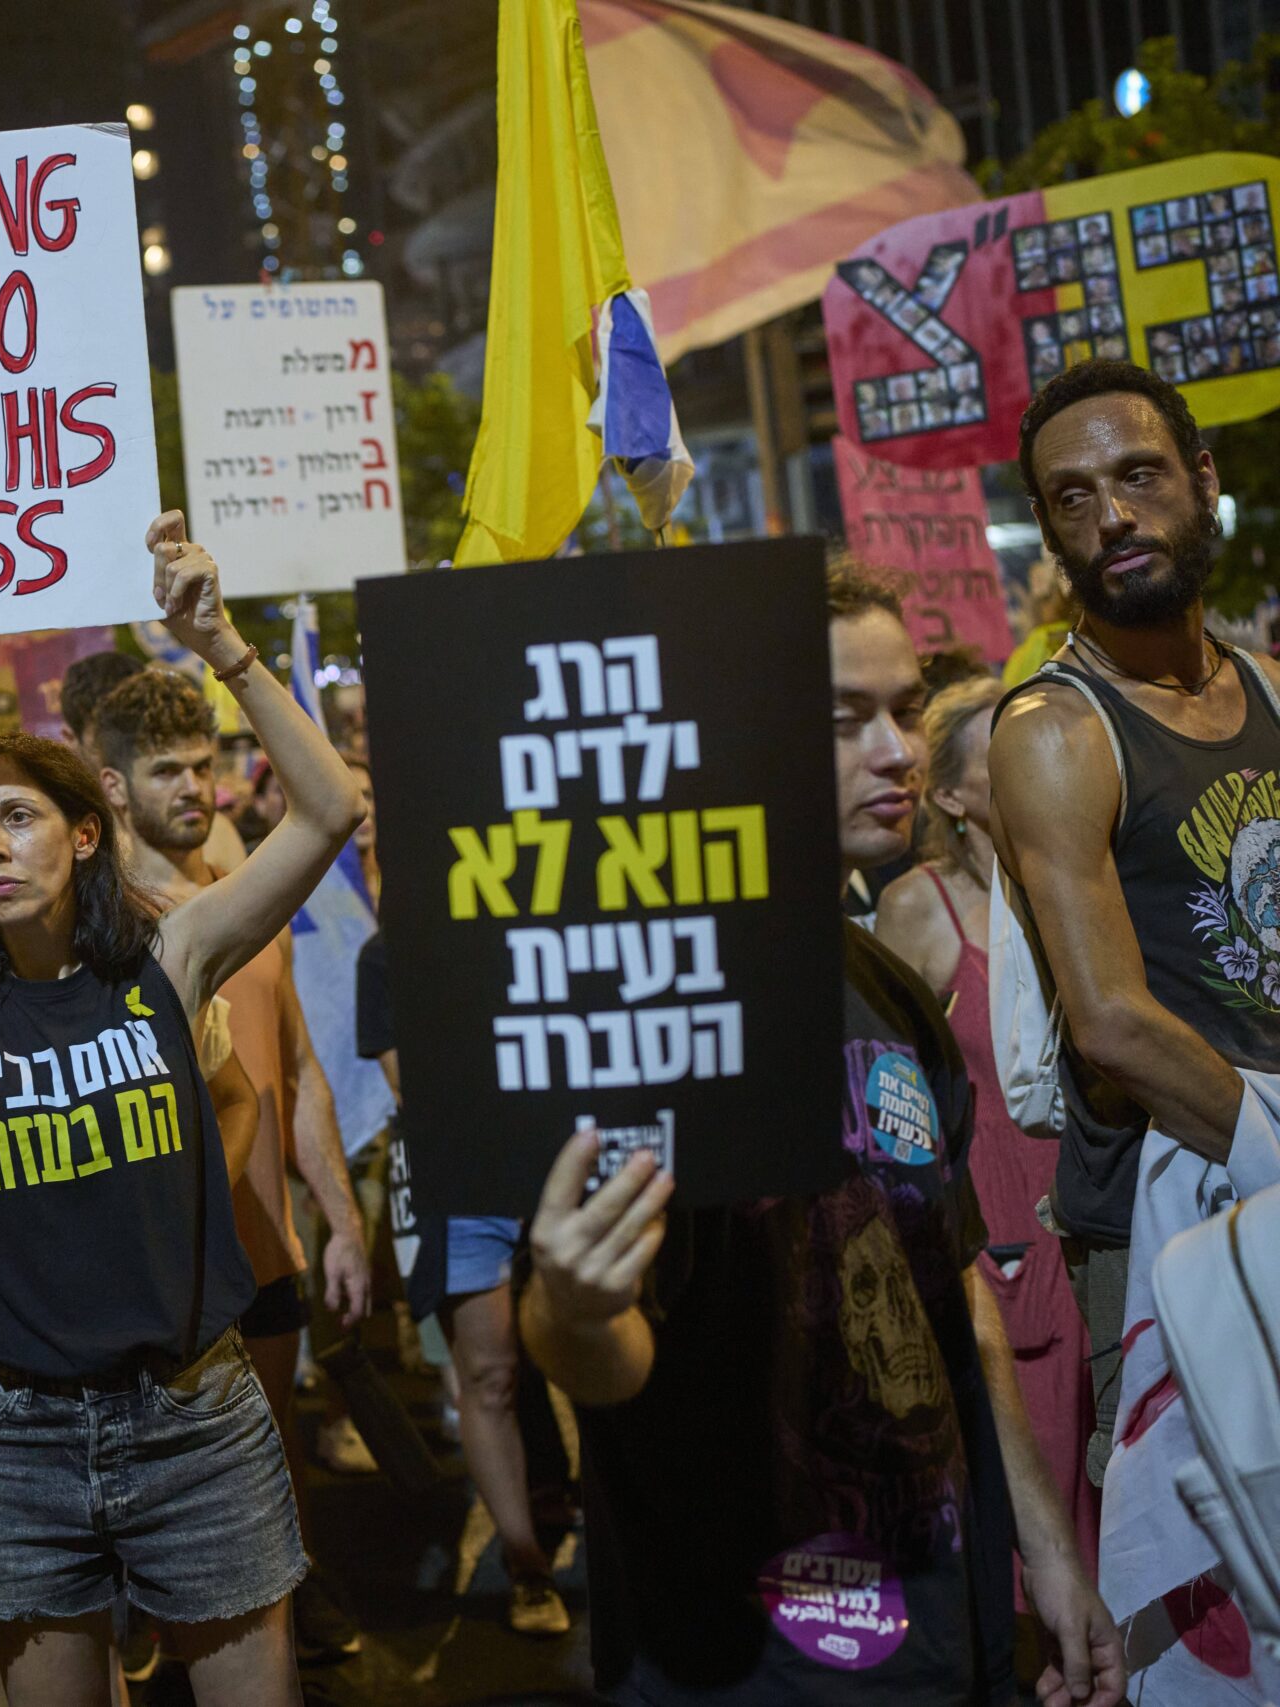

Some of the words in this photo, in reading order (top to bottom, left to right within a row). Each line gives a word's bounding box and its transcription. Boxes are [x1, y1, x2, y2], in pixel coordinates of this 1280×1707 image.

[202, 293, 235, 319] על
[250, 296, 357, 319] החטופים
[0, 382, 117, 492] HIS
[204, 456, 273, 478] בגידה
[523, 635, 663, 721] הרג
[499, 715, 700, 810] ילדים
[447, 807, 572, 920] לא
[595, 804, 769, 911] הוא
[1177, 772, 1245, 883] WILD
[505, 916, 725, 1004] בעיית
[69, 1019, 170, 1097] אתם
[493, 1001, 743, 1091] הסברה
[115, 1082, 182, 1162] הם
[782, 1553, 882, 1587] מסרבים
[778, 1603, 837, 1624] الحرب
